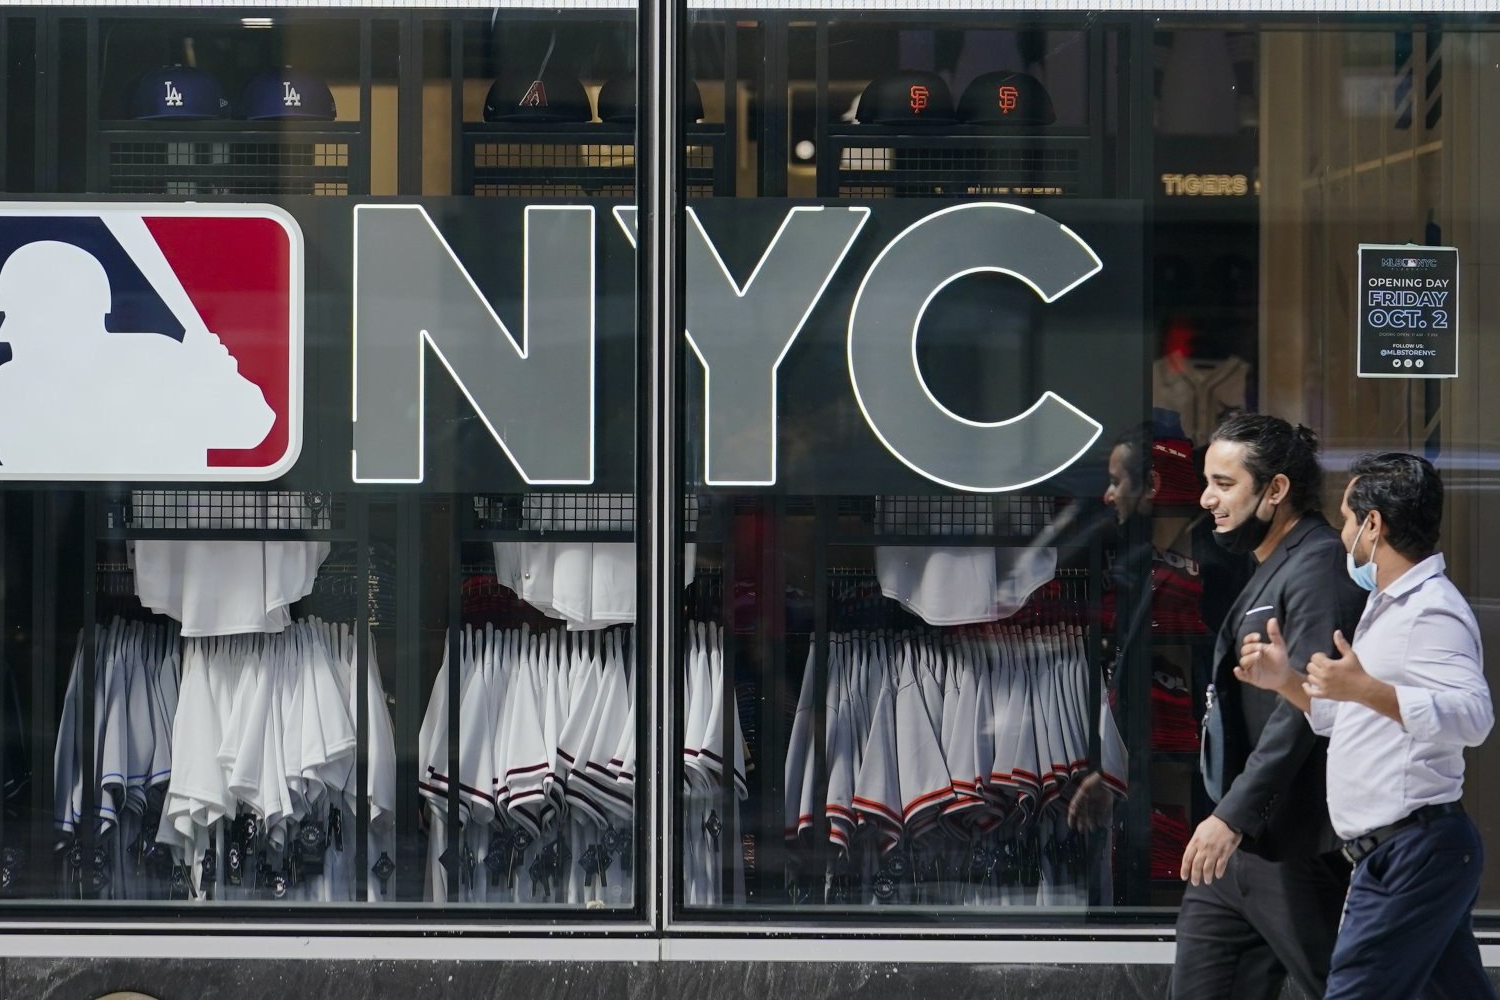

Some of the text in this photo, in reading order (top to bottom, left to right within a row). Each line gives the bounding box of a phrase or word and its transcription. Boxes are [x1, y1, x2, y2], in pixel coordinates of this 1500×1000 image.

[165, 81, 183, 106] LA
[283, 81, 301, 106] LA
[1161, 173, 1248, 196] TIGERS
[1368, 278, 1449, 288] OPENING DAY
[1368, 290, 1448, 307] FRIDAY
[1368, 309, 1448, 328] OCT. 2
[352, 201, 1104, 492] NYC
